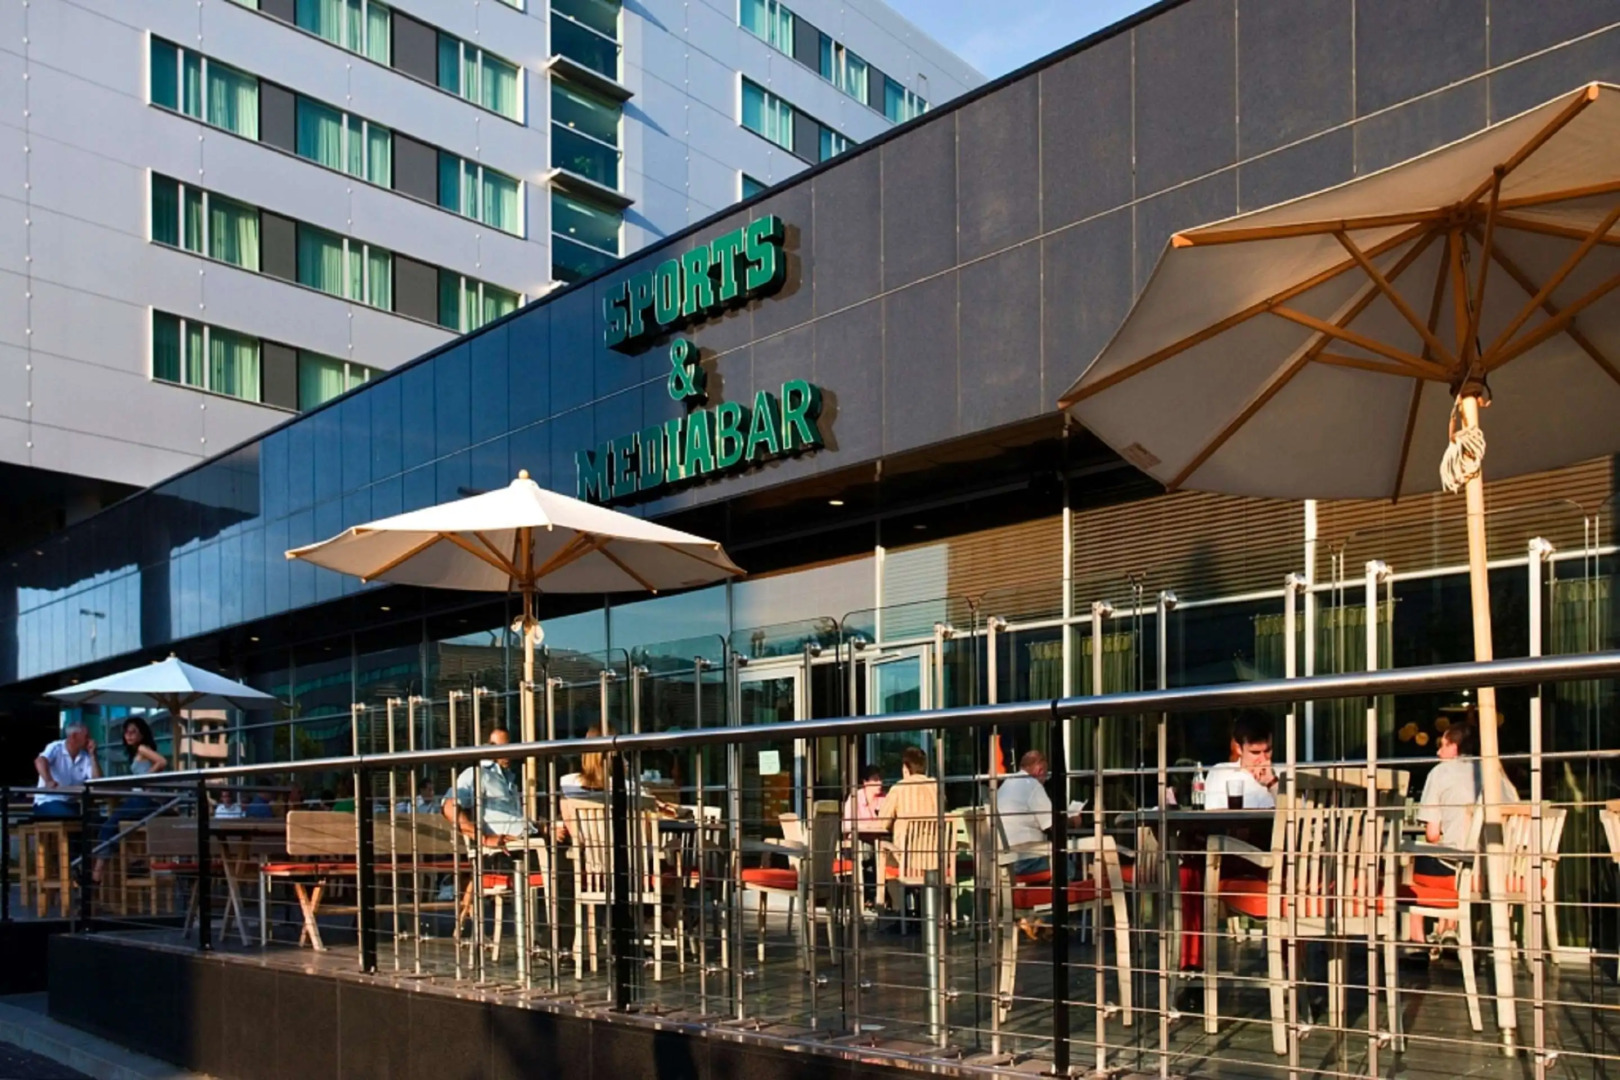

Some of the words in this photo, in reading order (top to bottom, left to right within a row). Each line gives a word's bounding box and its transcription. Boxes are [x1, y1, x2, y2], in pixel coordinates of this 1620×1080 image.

[603, 213, 781, 350] SPORTS
[667, 338, 701, 400] &
[575, 379, 818, 502] MEDIABAR
